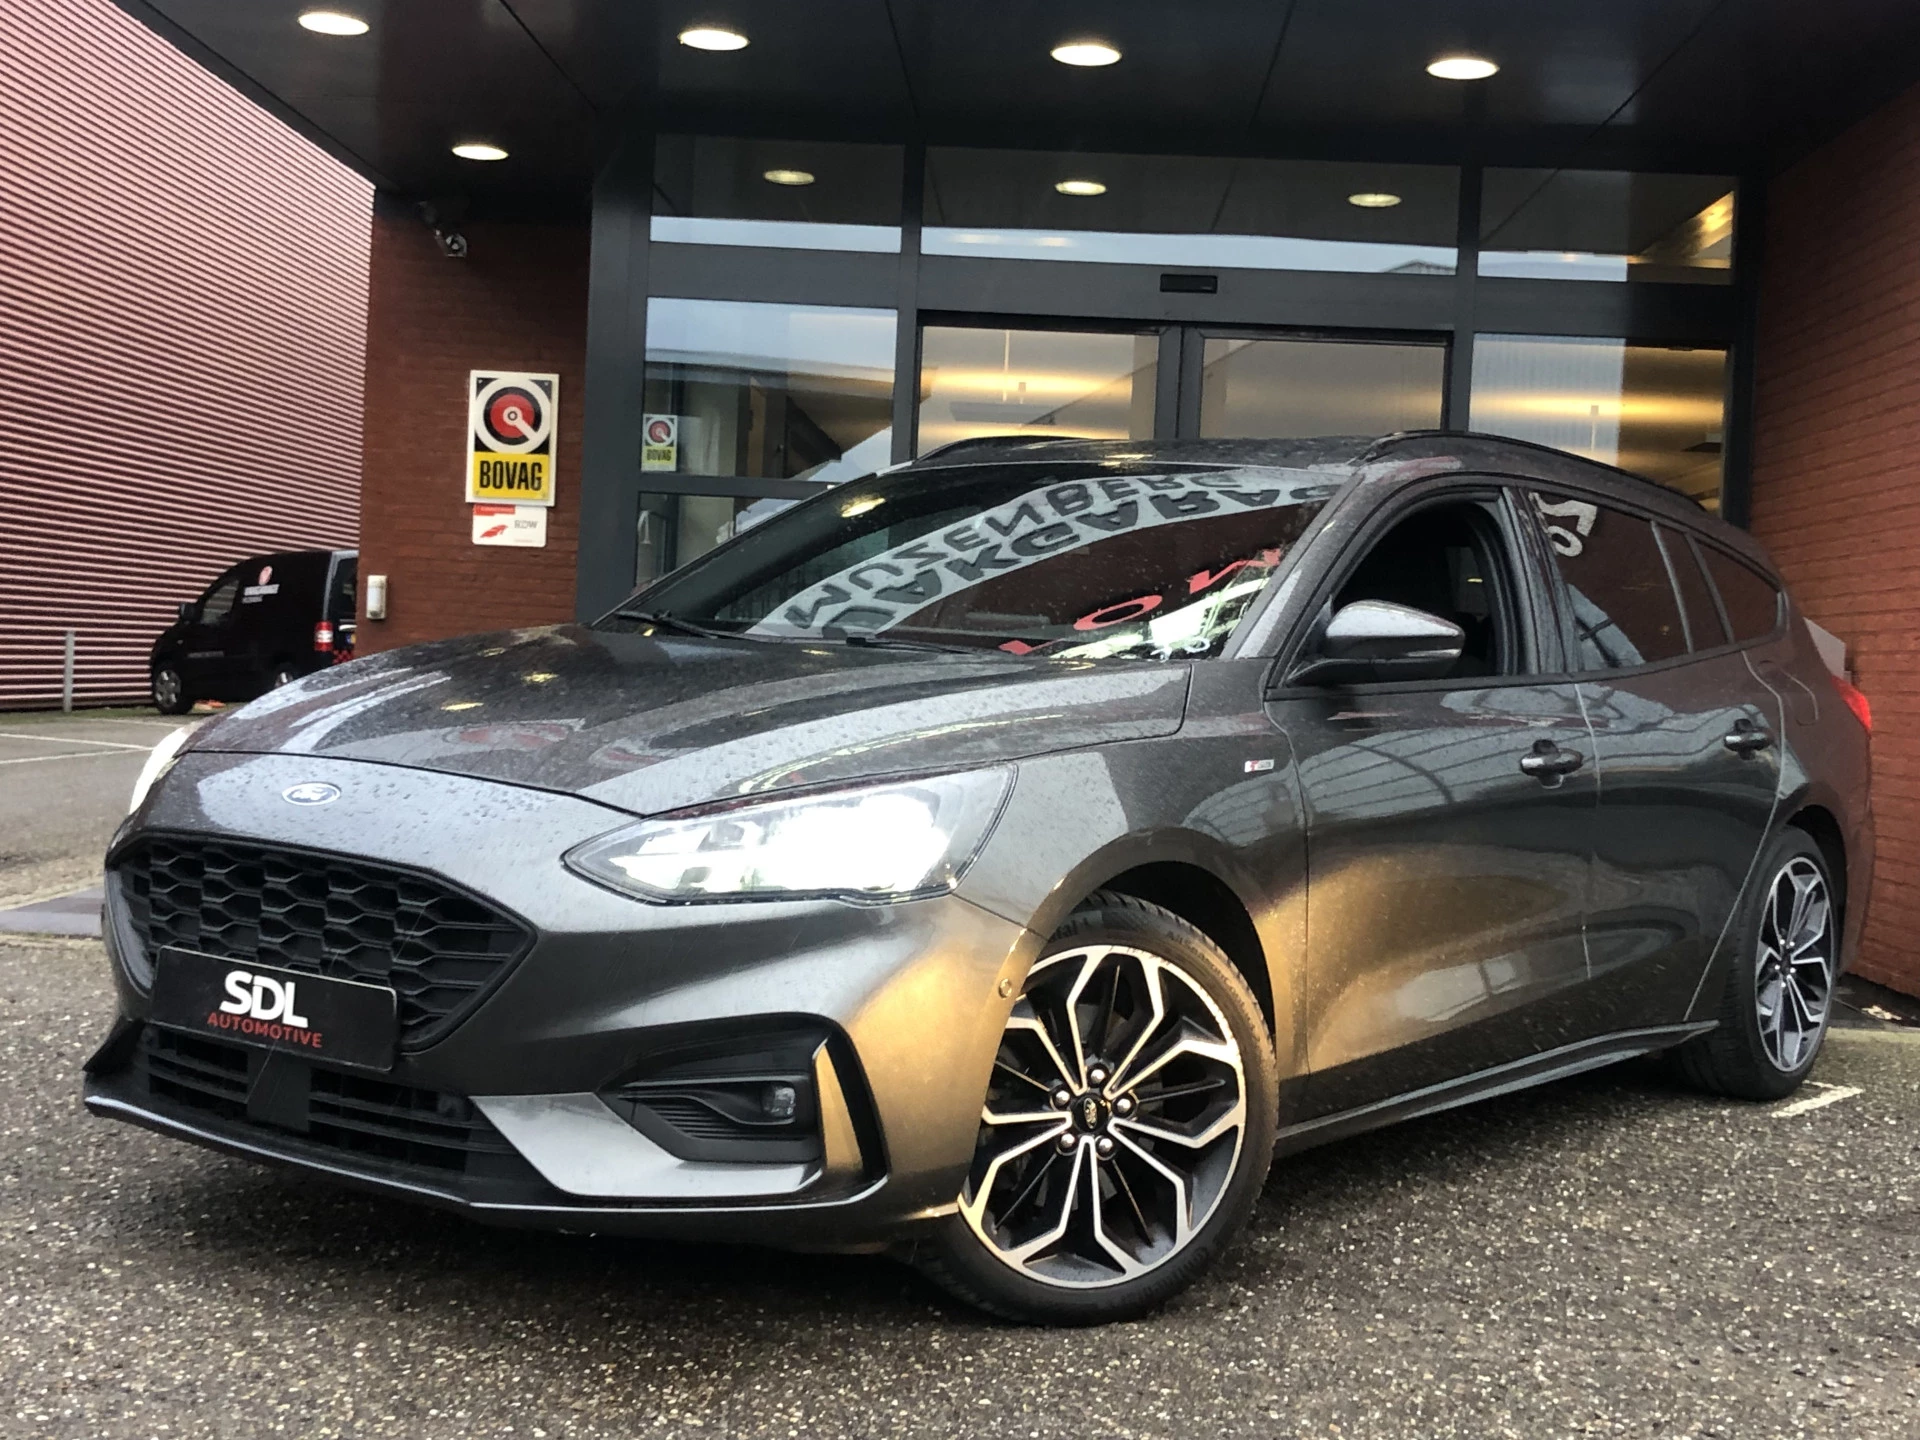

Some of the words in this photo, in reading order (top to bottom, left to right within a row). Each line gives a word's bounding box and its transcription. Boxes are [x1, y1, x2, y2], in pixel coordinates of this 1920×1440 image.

[646, 448, 672, 461] BOVAG
[479, 460, 543, 491] BOVAG
[219, 970, 309, 1029] SDL
[207, 1011, 323, 1048] AUTOMOTIVE
